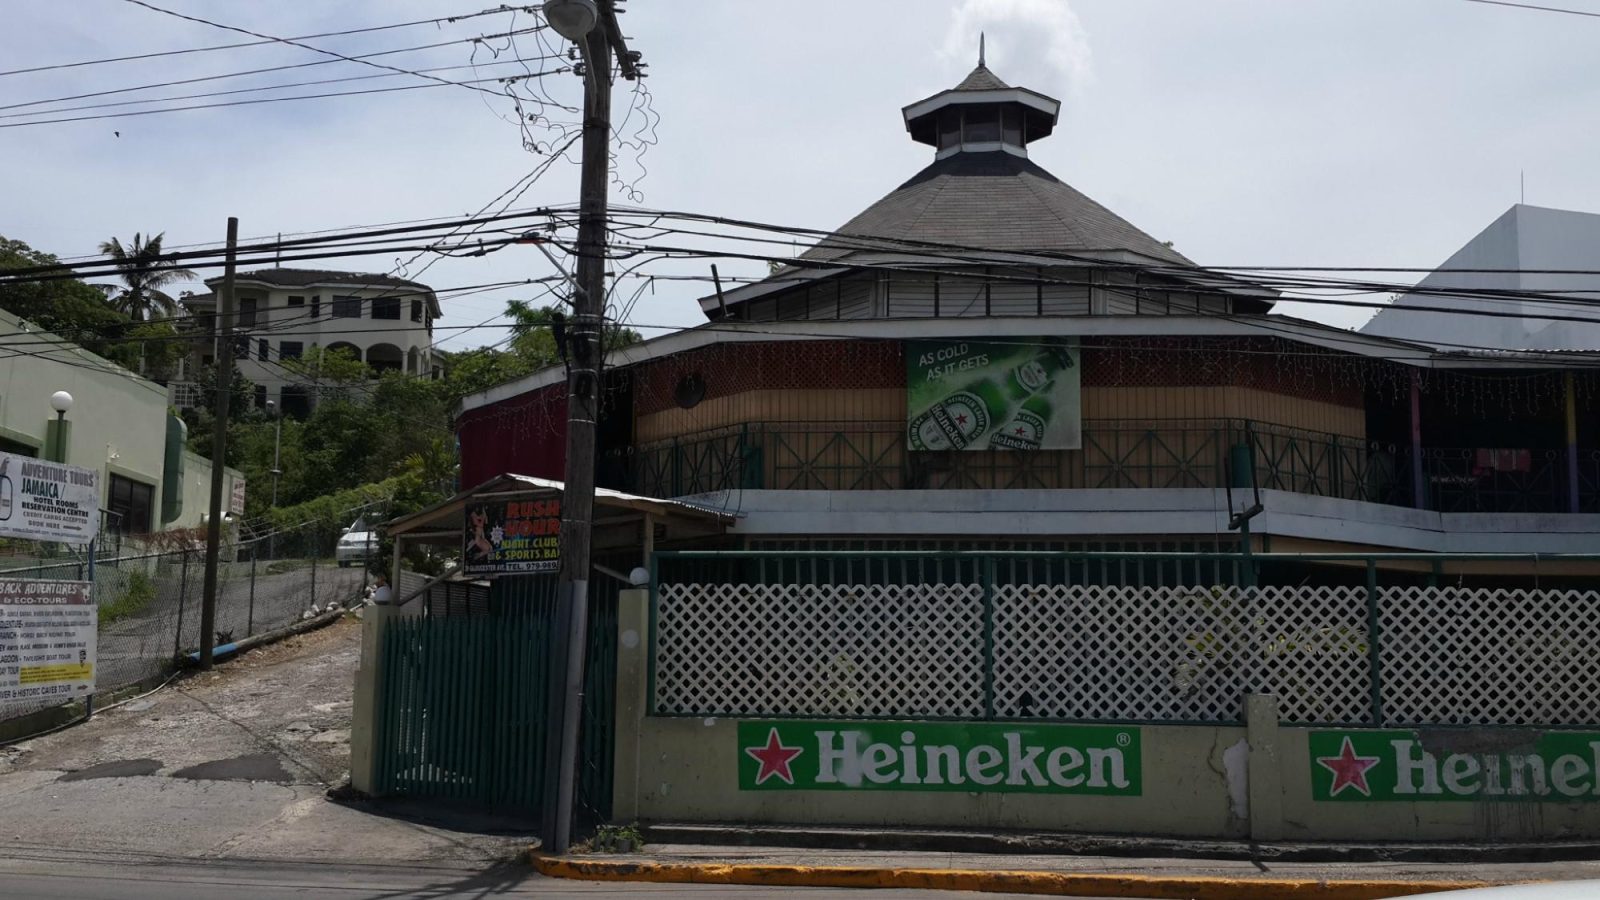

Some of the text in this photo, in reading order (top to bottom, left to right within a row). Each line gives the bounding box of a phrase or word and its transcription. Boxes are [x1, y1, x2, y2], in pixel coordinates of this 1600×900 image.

[919, 343, 969, 367] AS COLD
[926, 354, 990, 382] AS IT GETS
[931, 402, 966, 451] Heineken
[21, 462, 94, 487] ADVENTURE TOURS
[21, 478, 59, 499] JAMAICA
[22, 501, 65, 514] RESERVATION
[67, 508, 89, 518] CENTRE
[34, 496, 79, 509] HOTEL ROOMS
[506, 501, 560, 517] RUSH
[505, 519, 560, 537] HOUR
[501, 537, 558, 548] NIGHT CLUB
[505, 549, 540, 560] SPORTS
[25, 583, 78, 595] ADVENTURES
[813, 730, 1130, 789] Heineken
